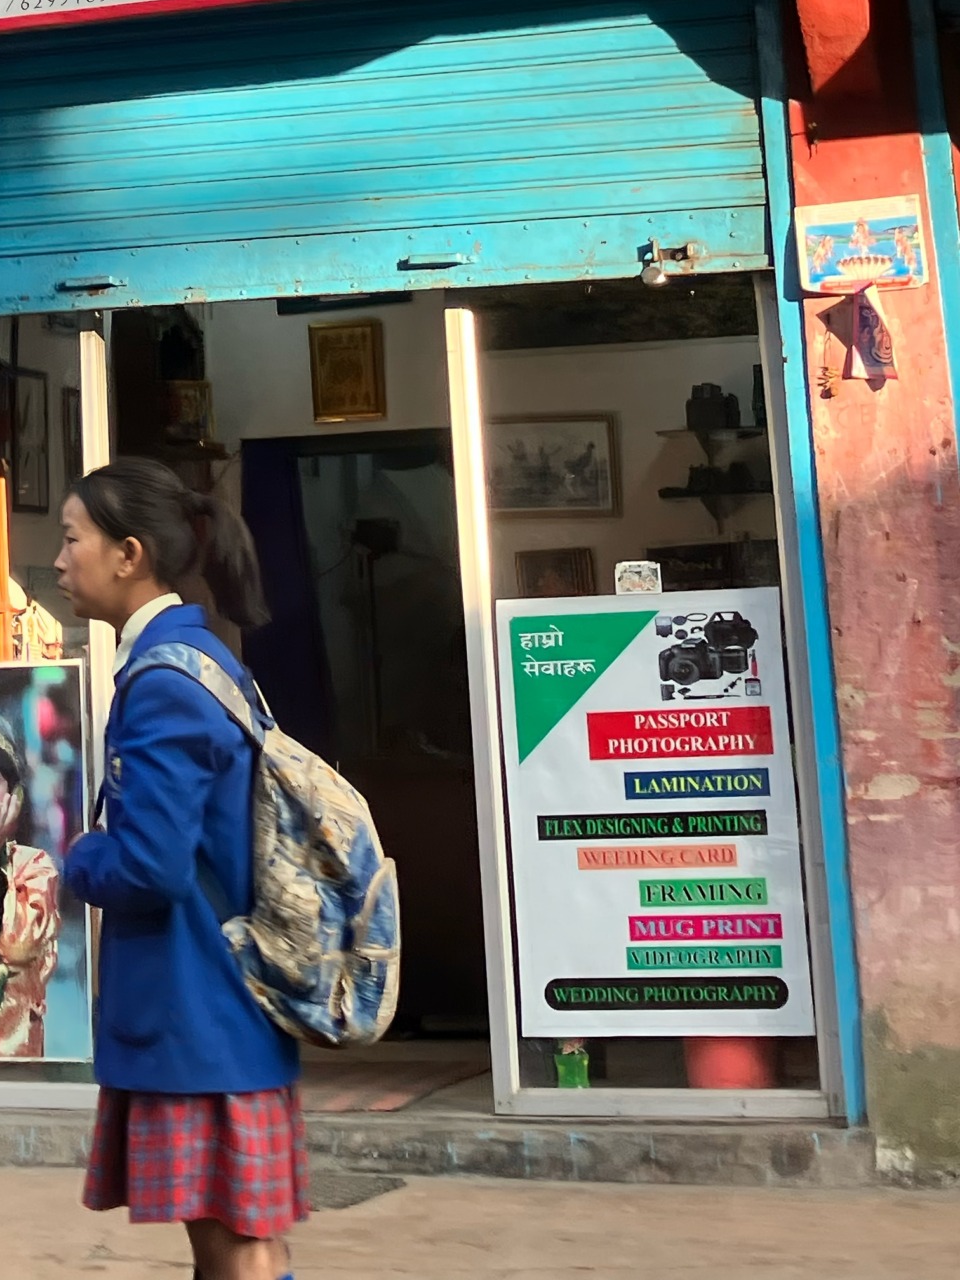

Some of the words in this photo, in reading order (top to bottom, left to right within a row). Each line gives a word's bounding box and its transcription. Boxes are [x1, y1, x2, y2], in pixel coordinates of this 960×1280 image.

[518, 624, 564, 650] हाम्रो
[521, 654, 595, 677] सेवाहरू
[634, 711, 730, 730] PASSPORT
[608, 734, 757, 755] PHOTOGRAPHY
[633, 774, 763, 794] LAMINATION
[545, 818, 583, 836] FLEX
[586, 817, 668, 835] DESIGNING
[672, 818, 684, 833] &
[688, 815, 761, 832] PRINTING
[679, 847, 735, 864] CARD
[646, 882, 762, 902] FRAMING
[635, 920, 695, 936] MUG
[702, 918, 779, 935] PRINT
[631, 949, 774, 965] VIDEOGRAPHY
[553, 986, 639, 1003] WEDDING
[644, 984, 779, 1002] PHOTOGRAPHY
